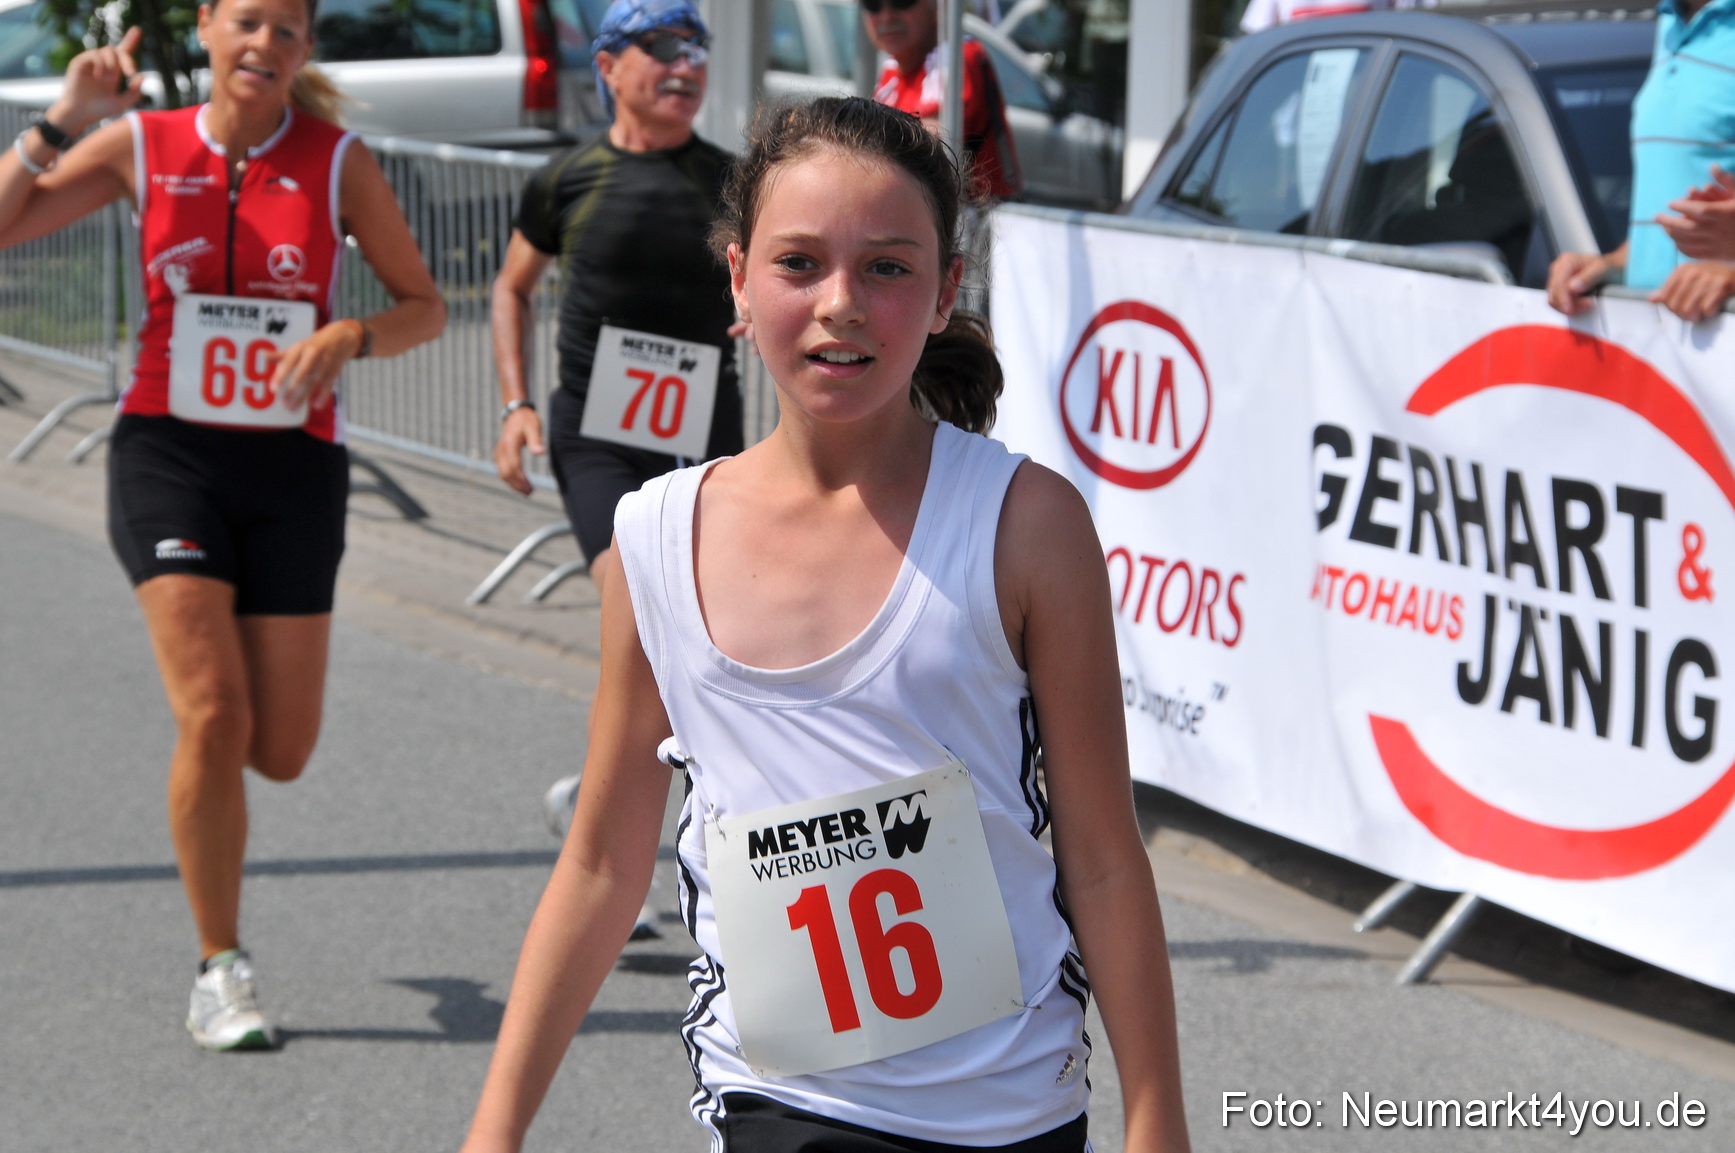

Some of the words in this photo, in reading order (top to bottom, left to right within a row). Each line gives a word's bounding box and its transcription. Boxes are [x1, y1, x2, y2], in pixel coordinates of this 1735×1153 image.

[202, 338, 279, 409] 69
[621, 368, 688, 439] 70
[1089, 345, 1181, 450] KIA
[1311, 422, 1667, 610] GERHART
[1677, 521, 1716, 606] &
[1106, 546, 1247, 648] OTORS
[1310, 563, 1465, 642] TOHAUS
[1457, 591, 1722, 764] JÄNIG
[747, 807, 871, 861] MEYER
[750, 839, 877, 883] WERBUNG
[786, 867, 943, 1034] 16
